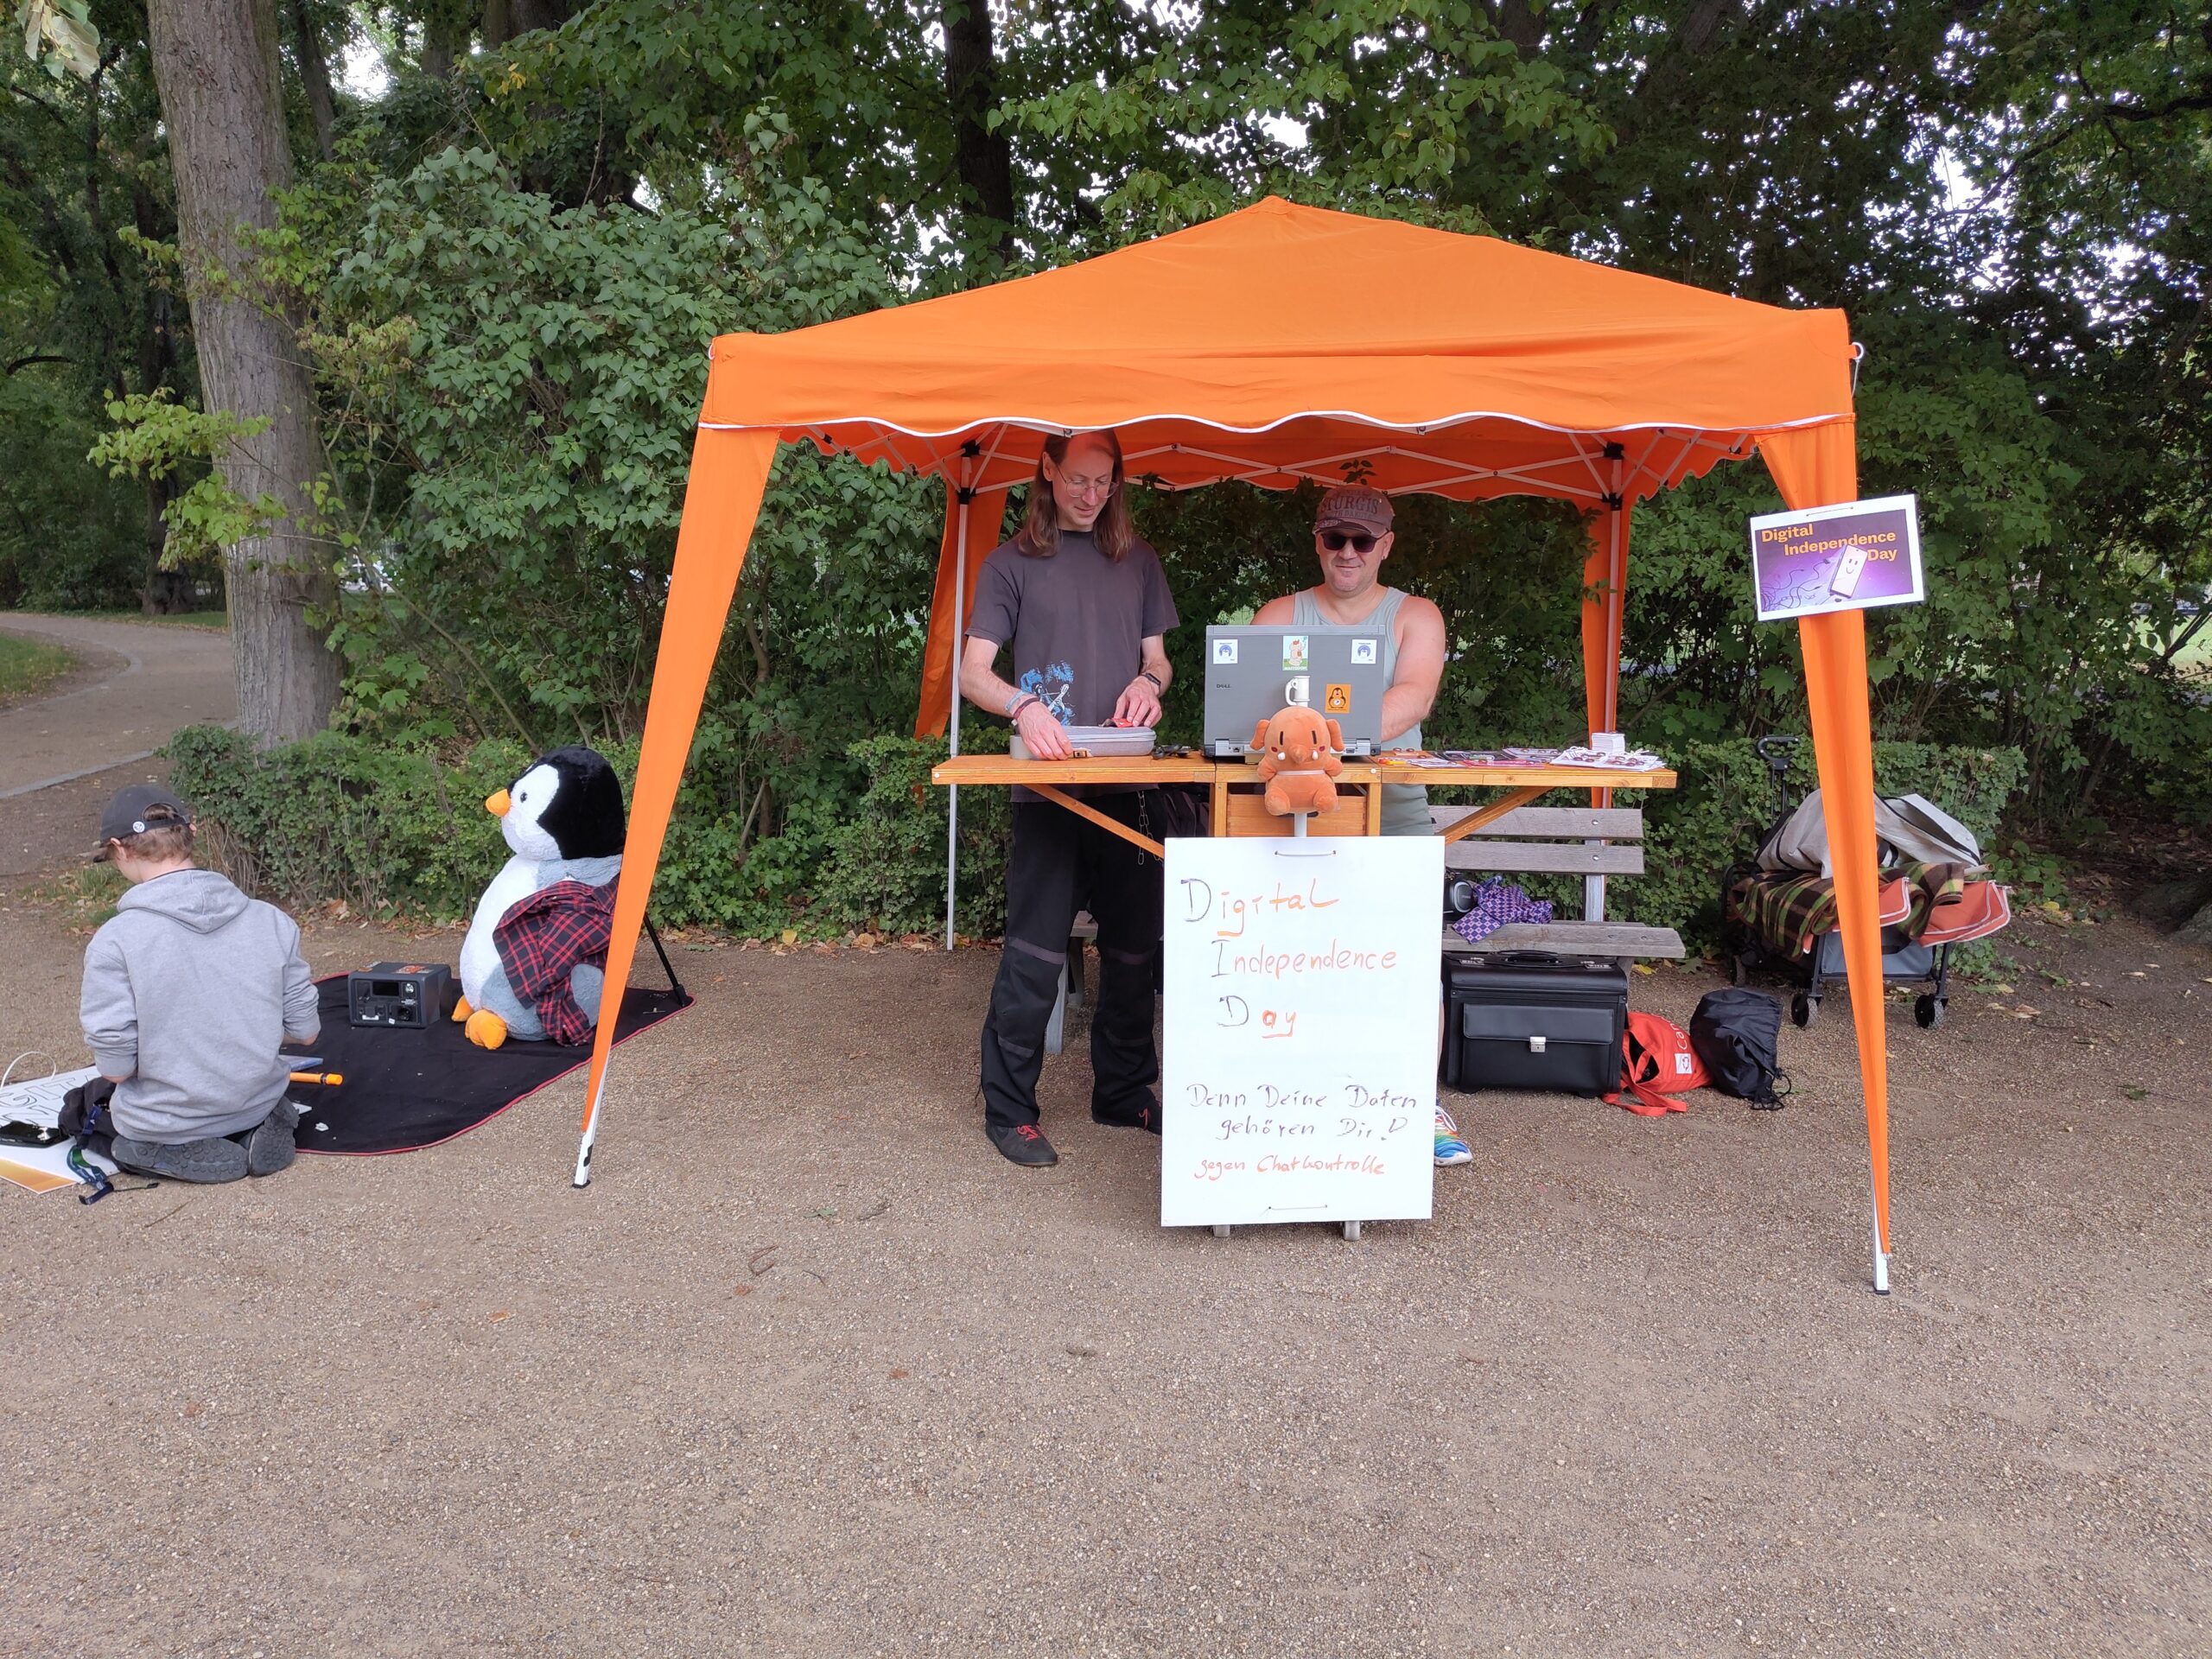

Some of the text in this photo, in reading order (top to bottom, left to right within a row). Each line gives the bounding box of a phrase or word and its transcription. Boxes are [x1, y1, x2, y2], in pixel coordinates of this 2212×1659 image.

[1320, 495, 1379, 514] STURGIS
[1762, 524, 1814, 543] Digital
[1784, 531, 1897, 556] Independence
[1867, 547, 1898, 562] Day
[1211, 938, 1397, 979] Independence
[1217, 995, 1296, 1039] Day
[1186, 1084, 1417, 1109] Denn Deine Daten
[1215, 1116, 1315, 1141] gehören
[1194, 1154, 1386, 1181] gegen Chatkontrolle
